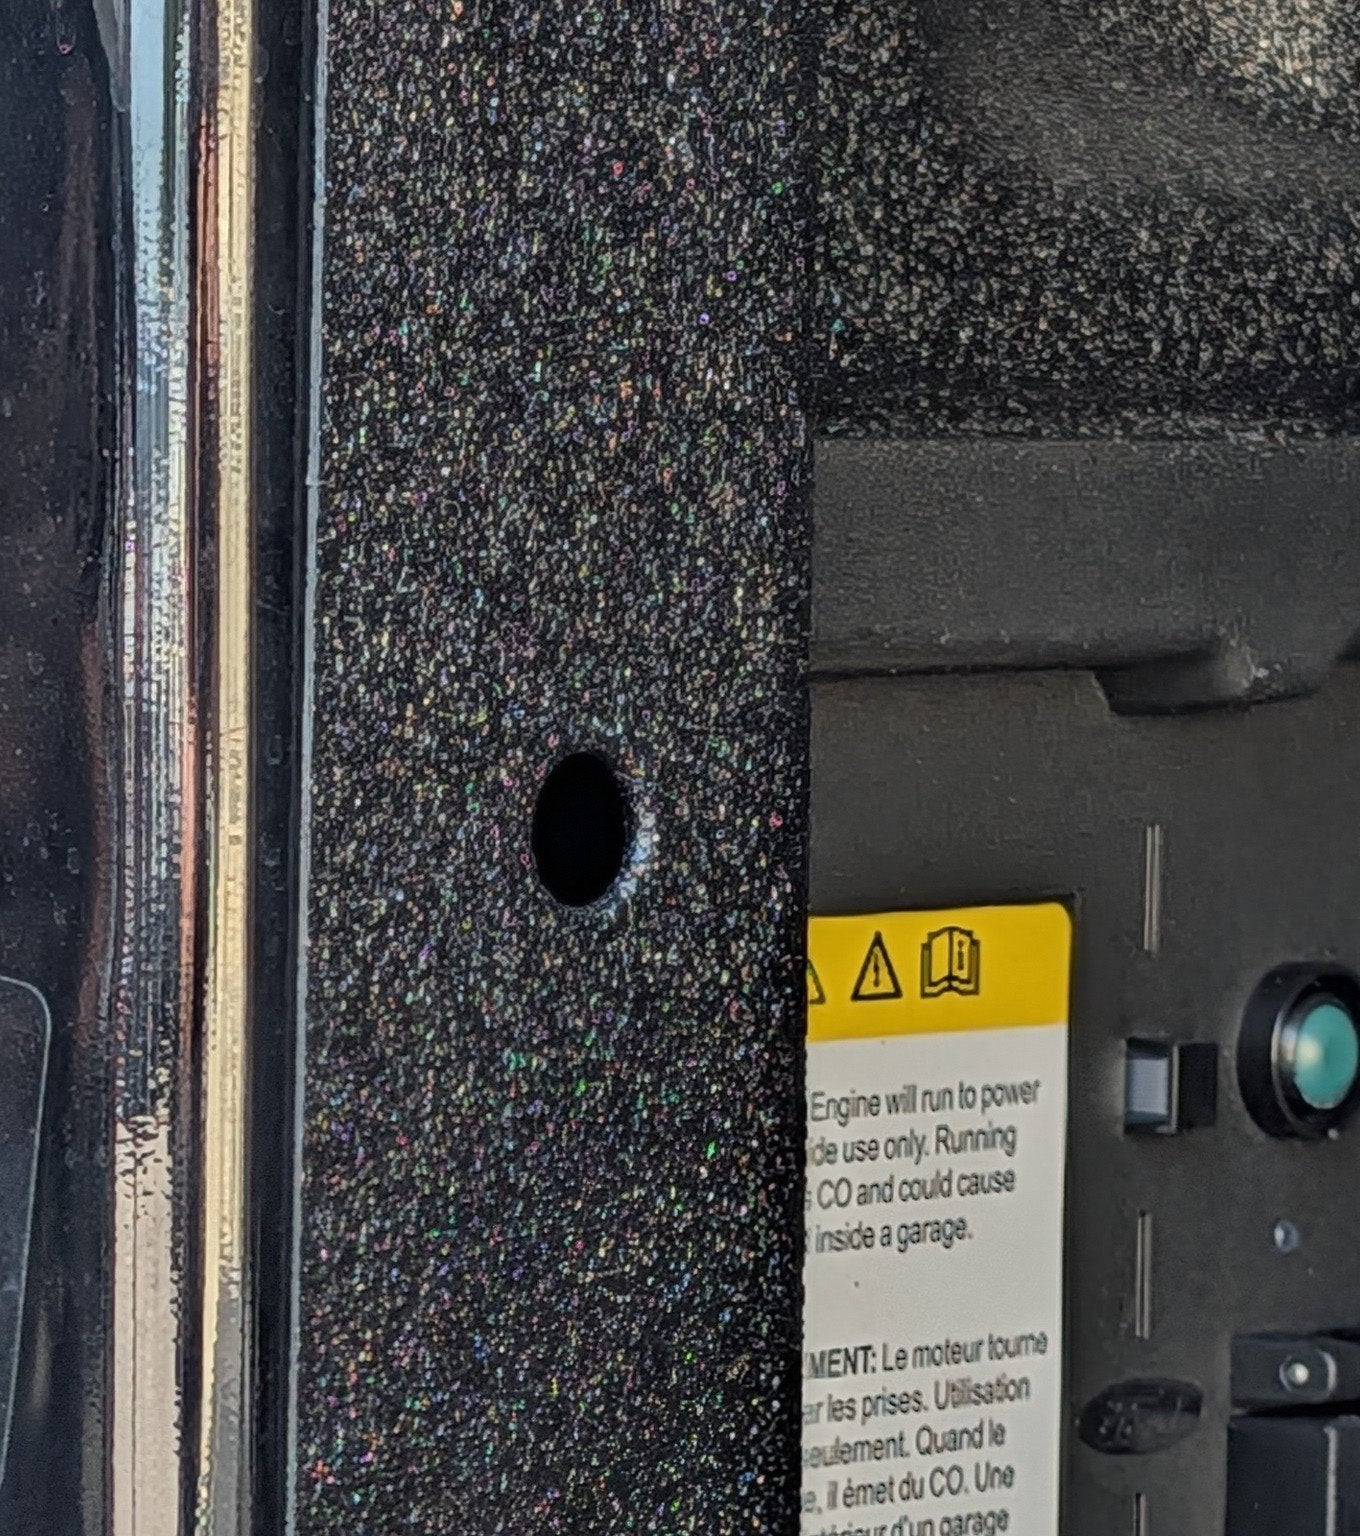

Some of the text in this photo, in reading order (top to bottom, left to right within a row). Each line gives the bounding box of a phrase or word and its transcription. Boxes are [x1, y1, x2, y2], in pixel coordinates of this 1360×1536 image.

[811, 1079, 1041, 1128] Engine will run to power
[843, 1139, 879, 1163] use
[884, 1128, 930, 1165] only.
[935, 1122, 1017, 1157] Running
[817, 1177, 852, 1210] CO
[857, 1173, 894, 1206] and
[898, 1168, 953, 1201] could
[957, 1168, 1016, 1196] cause
[815, 1221, 875, 1253] inside
[880, 1225, 891, 1247] a
[897, 1217, 974, 1253] garage.
[803, 1331, 1048, 1378] MENT: Le moteur tourne
[827, 1393, 856, 1422] les
[862, 1386, 928, 1426] prises.
[933, 1373, 1030, 1410] Utilisation
[915, 1419, 983, 1457] Quand
[988, 1419, 1006, 1447] le
[842, 1475, 894, 1508] émet
[898, 1471, 925, 1502] du
[929, 1464, 969, 1499] CO.
[974, 1461, 1015, 1493] Une
